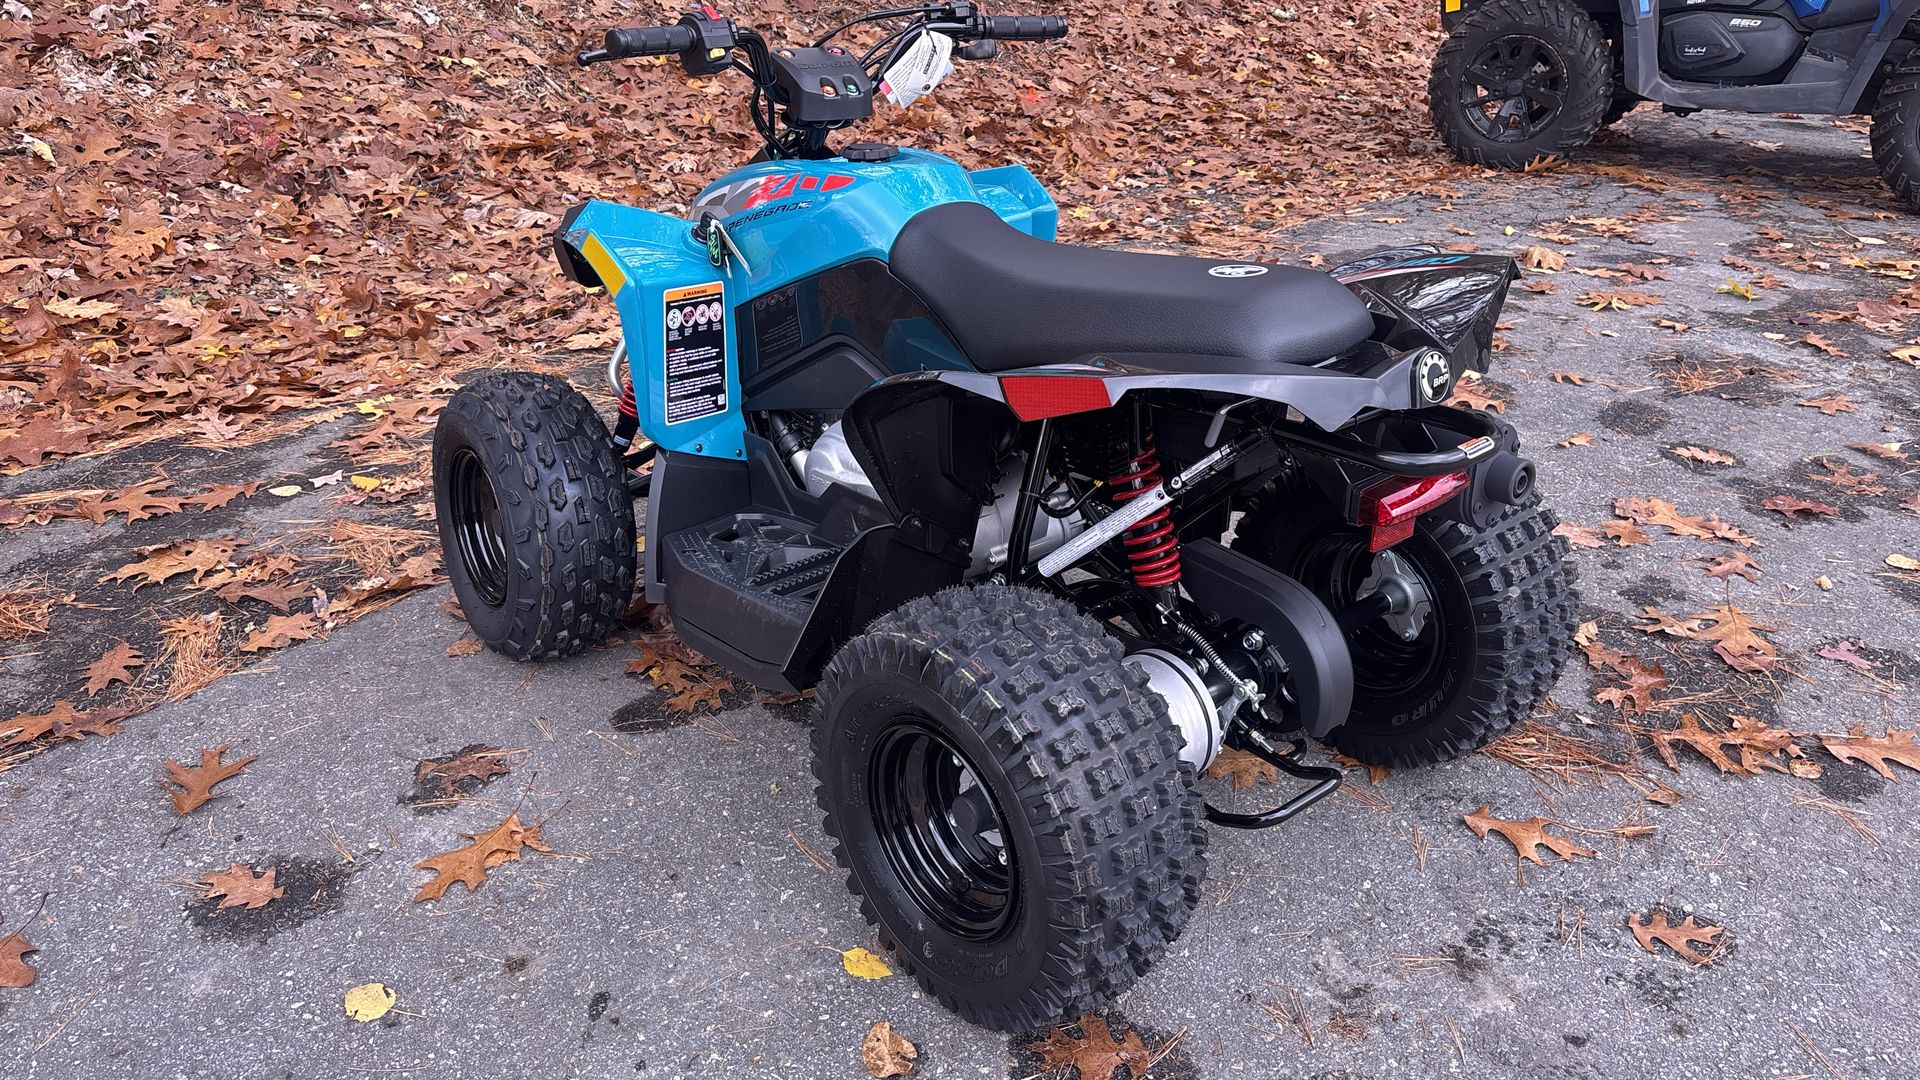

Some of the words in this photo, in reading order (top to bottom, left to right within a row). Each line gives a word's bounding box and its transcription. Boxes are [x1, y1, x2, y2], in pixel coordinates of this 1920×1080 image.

[724, 200, 812, 232] RENEGADE
[687, 289, 708, 297] WARNING
[1433, 374, 1448, 388] BRP
